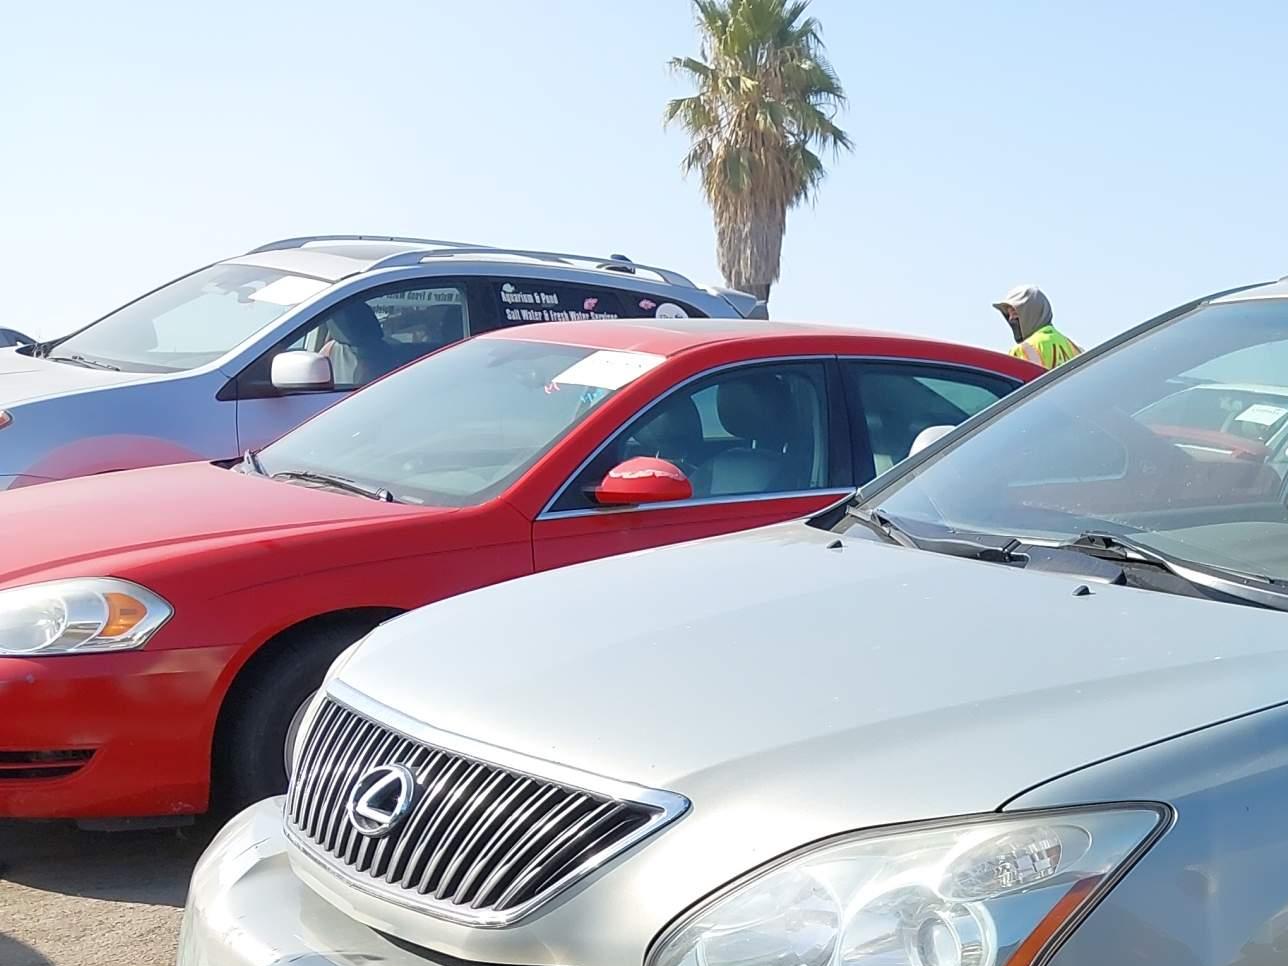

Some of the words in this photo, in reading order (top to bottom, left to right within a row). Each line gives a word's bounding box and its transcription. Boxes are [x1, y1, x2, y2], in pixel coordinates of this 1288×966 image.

[501, 292, 533, 304] Aquarium
[540, 293, 558, 304] Pond
[505, 308, 520, 320] Salt
[521, 309, 543, 320] Water
[549, 310, 570, 321] Fresh
